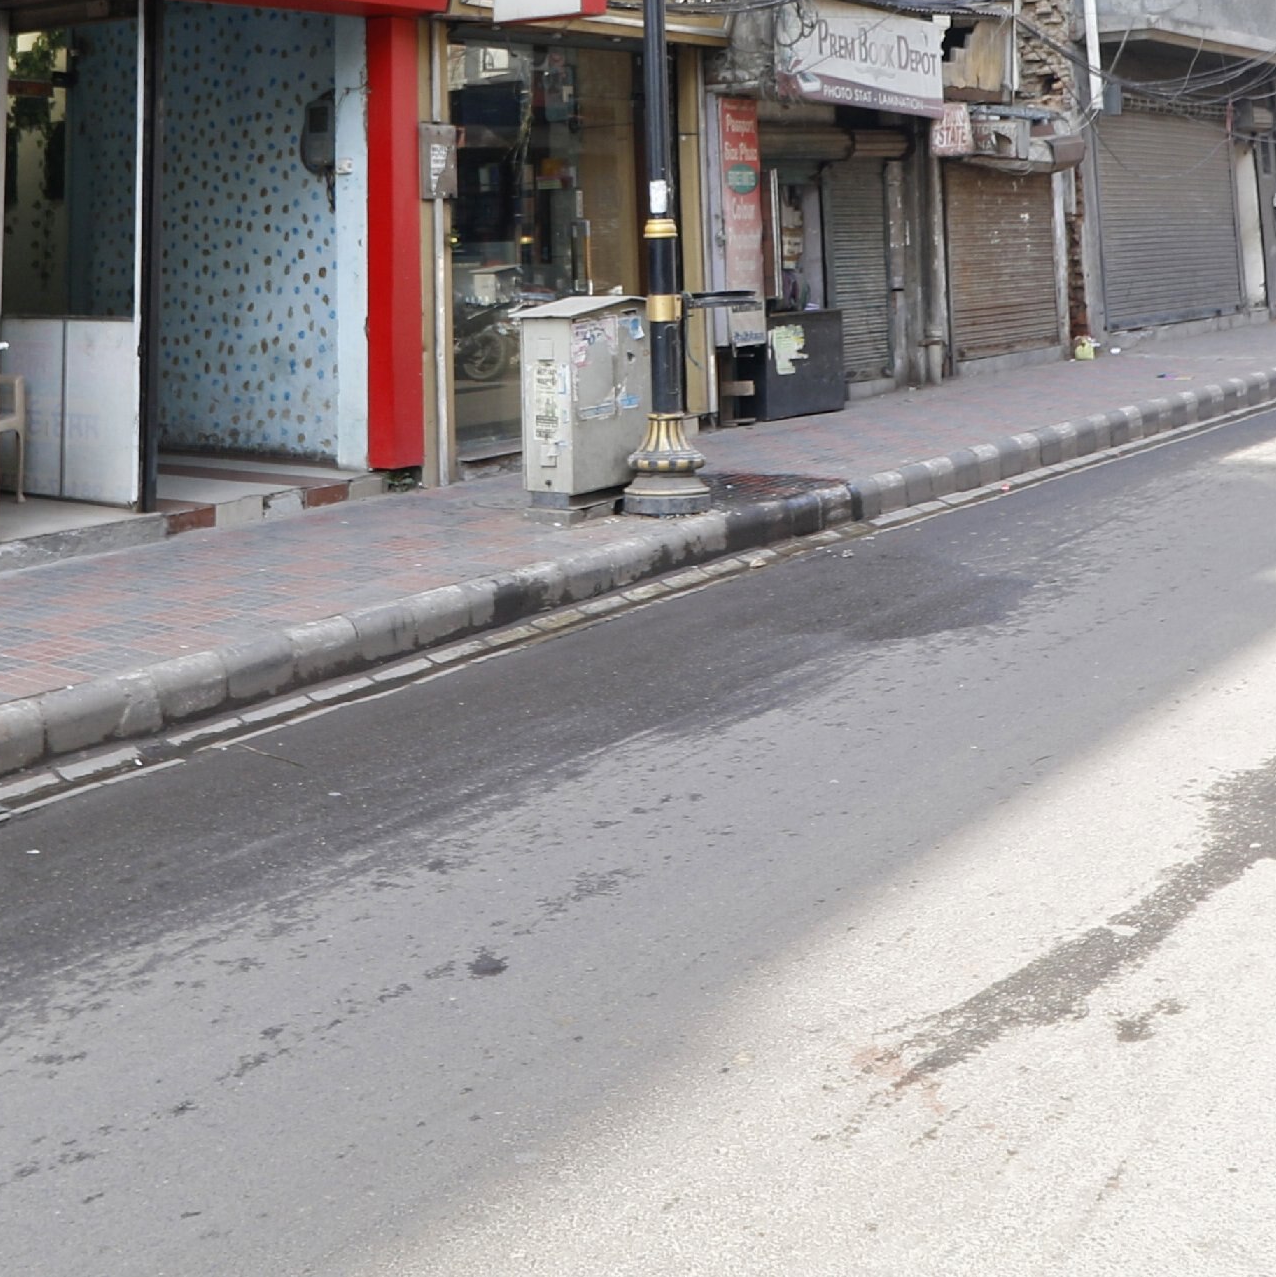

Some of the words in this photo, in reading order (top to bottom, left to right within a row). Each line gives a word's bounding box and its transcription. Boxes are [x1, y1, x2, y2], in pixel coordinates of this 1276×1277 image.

[817, 19, 856, 62] PREM
[858, 28, 896, 68] BOOK
[896, 35, 938, 77] DEPOT
[824, 85, 853, 101] PHOTO
[854, 90, 872, 103] STAT
